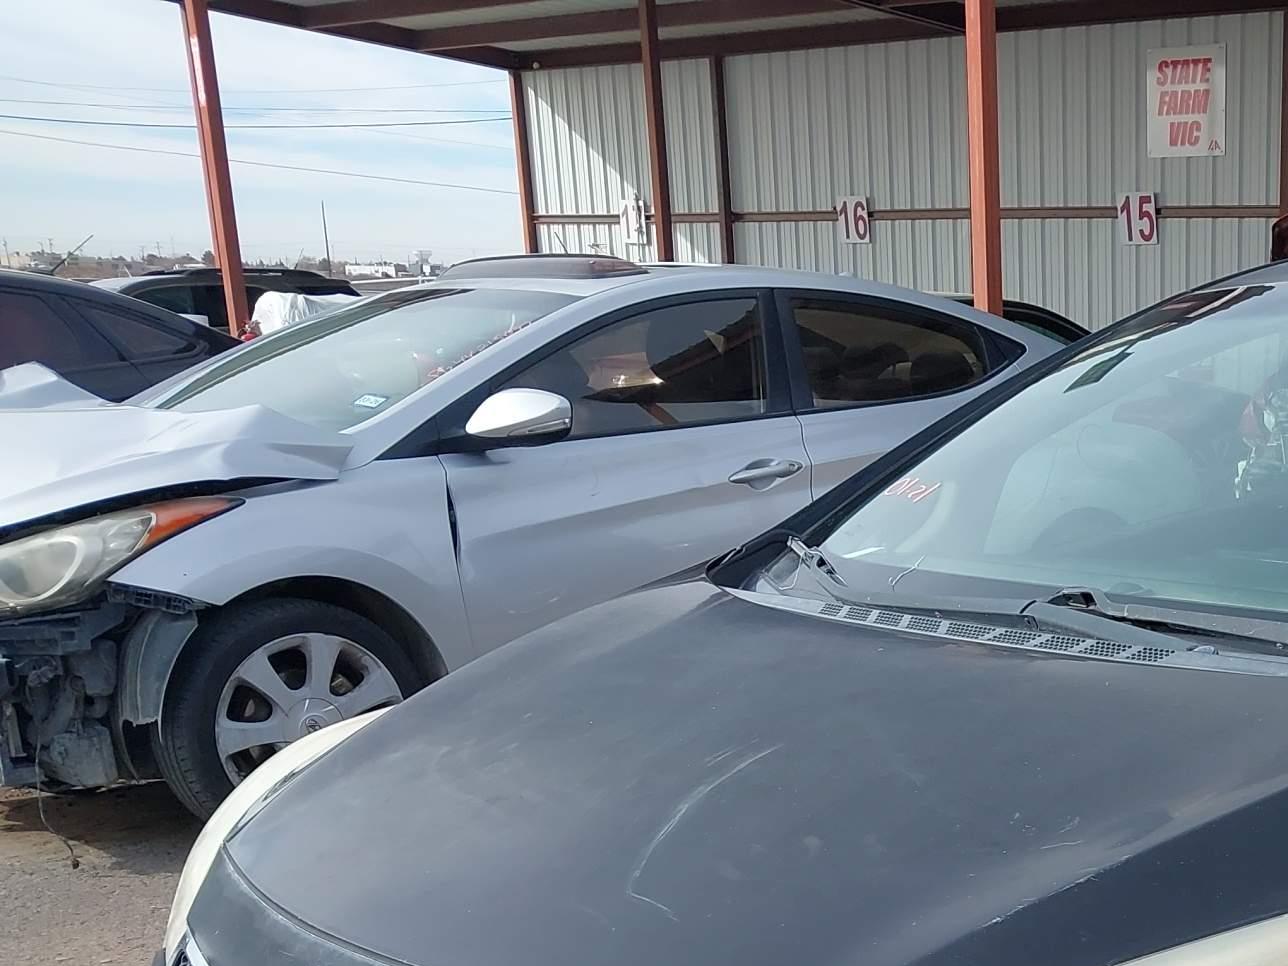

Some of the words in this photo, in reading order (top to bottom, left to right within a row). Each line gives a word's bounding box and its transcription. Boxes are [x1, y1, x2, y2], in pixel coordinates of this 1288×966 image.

[1156, 57, 1213, 87] STATE
[1157, 88, 1211, 117] FARM
[1168, 120, 1202, 147] VIC
[839, 200, 868, 241] 16
[1120, 195, 1155, 242] 15
